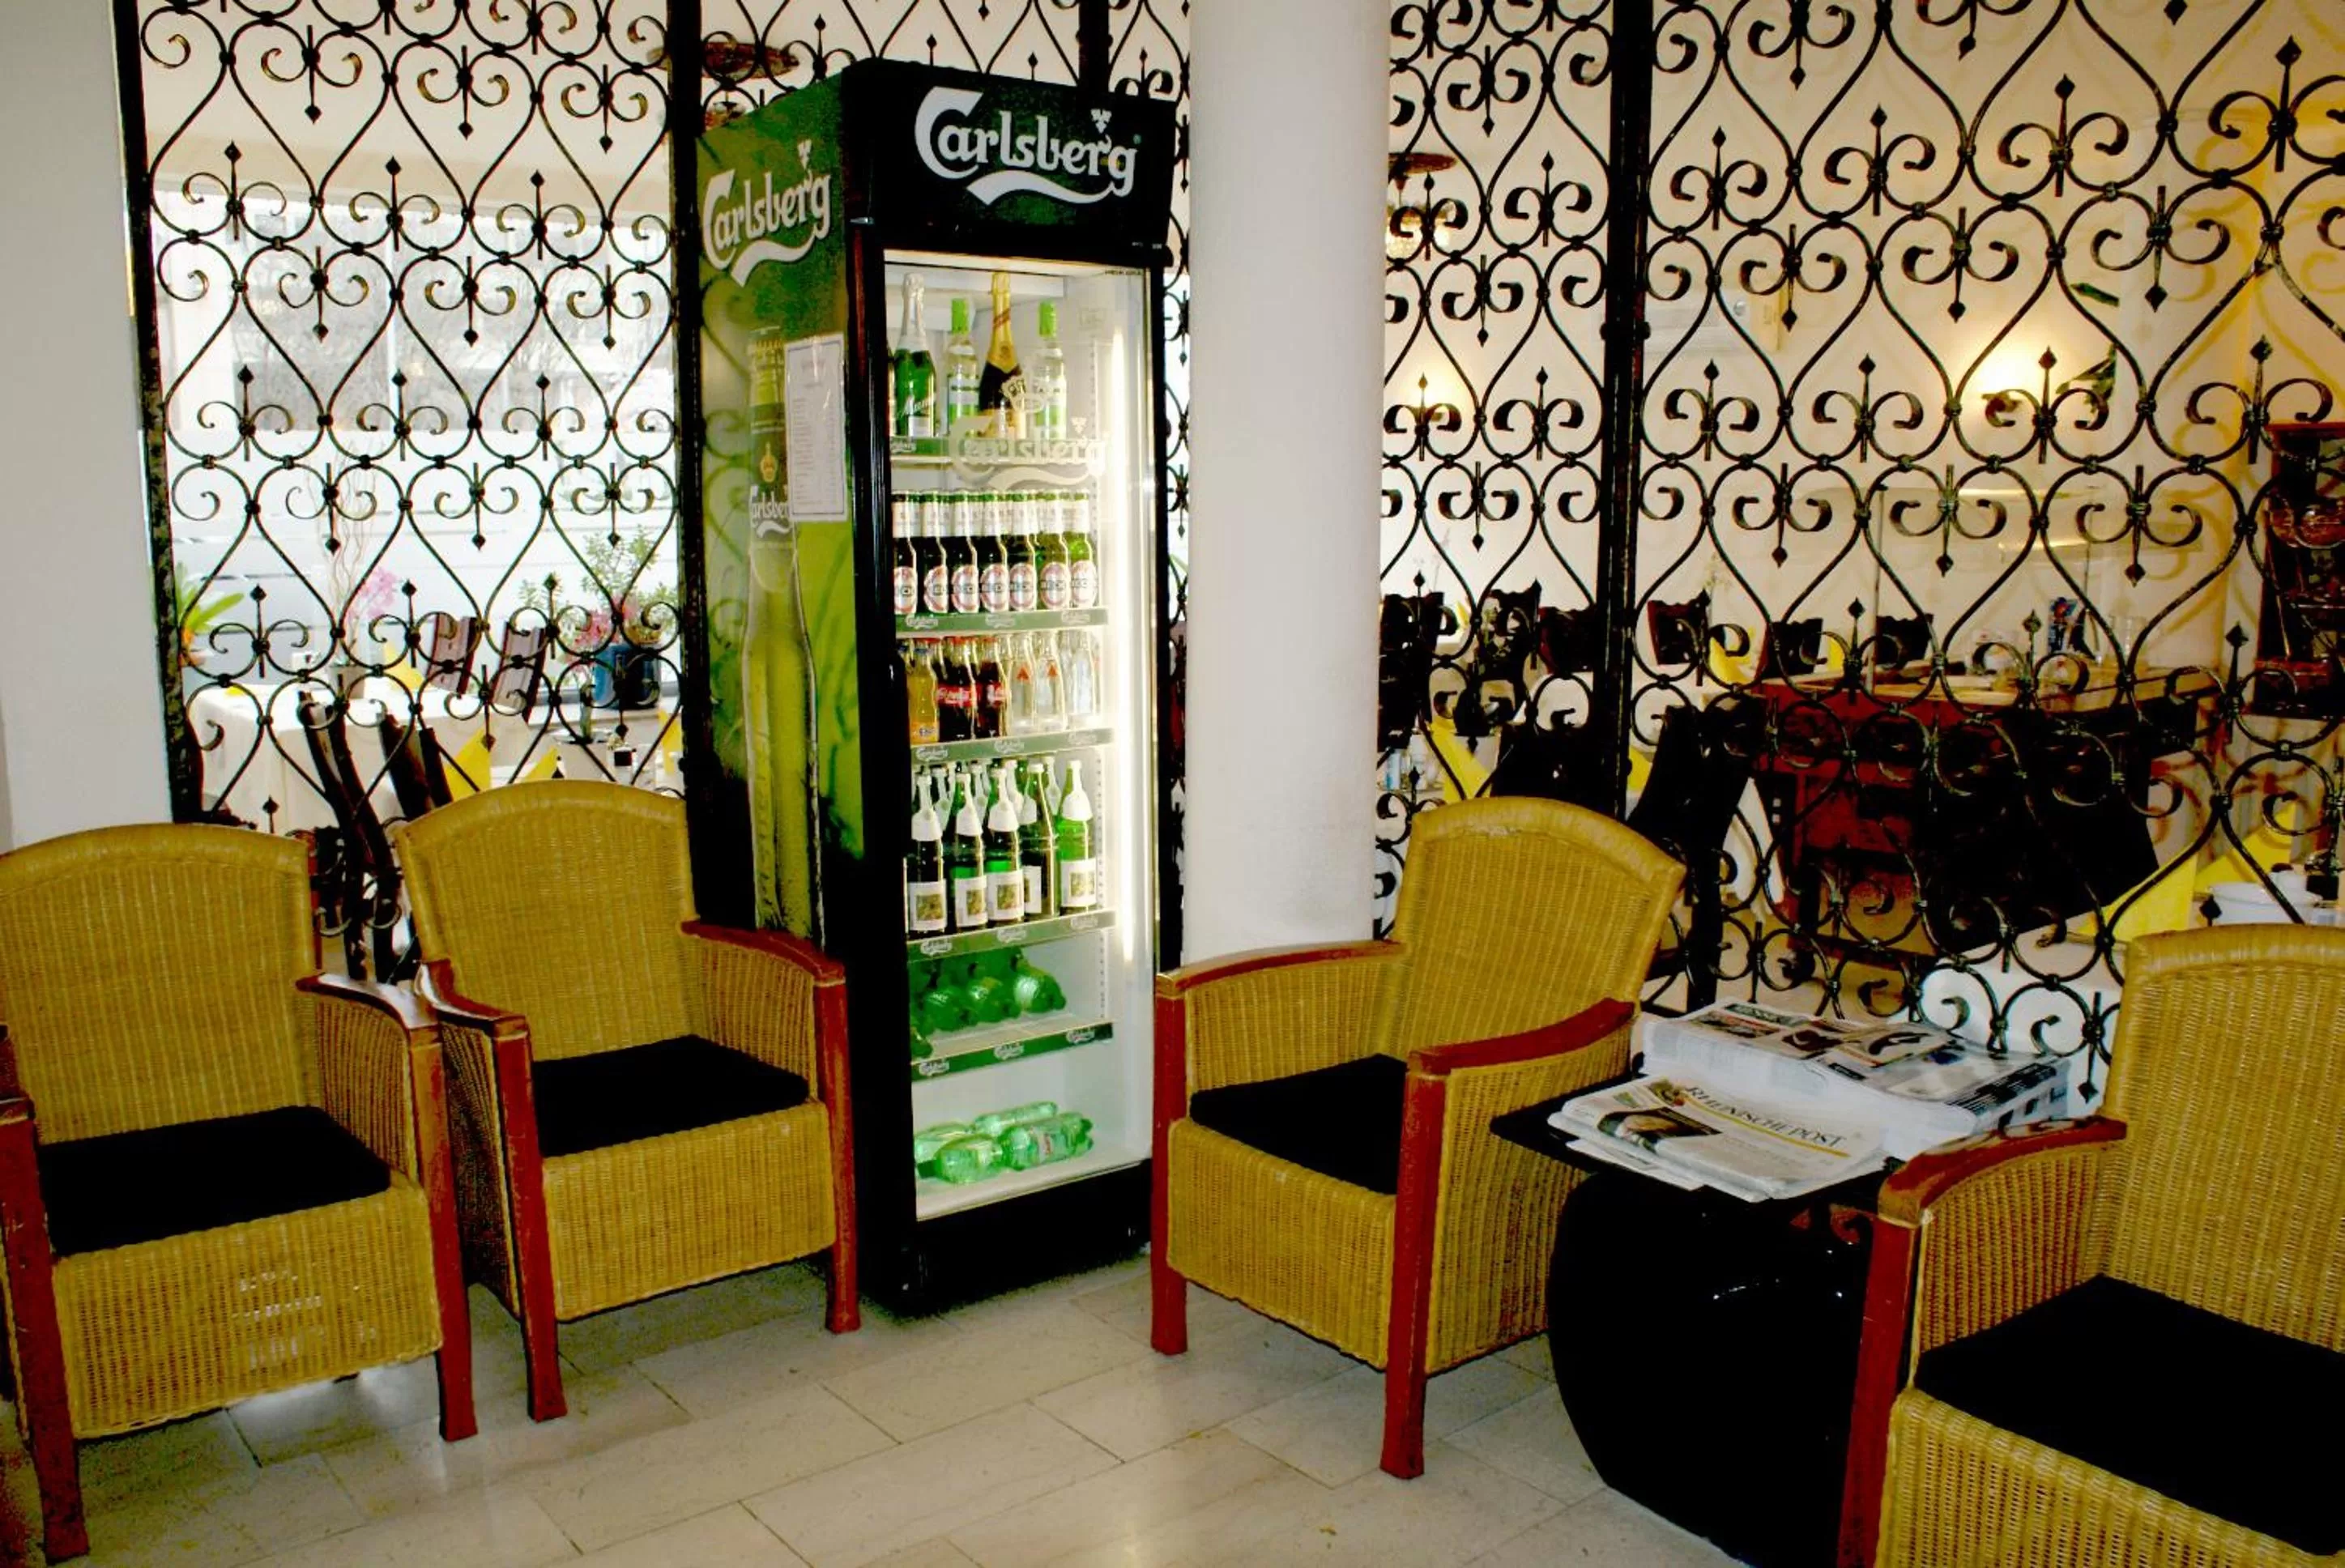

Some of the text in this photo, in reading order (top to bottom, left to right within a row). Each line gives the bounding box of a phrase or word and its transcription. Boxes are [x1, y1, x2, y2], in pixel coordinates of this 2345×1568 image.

[914, 86, 1137, 206] Carlsberg
[702, 165, 831, 287] Carlsberg
[1788, 1126, 1848, 1148] POST
